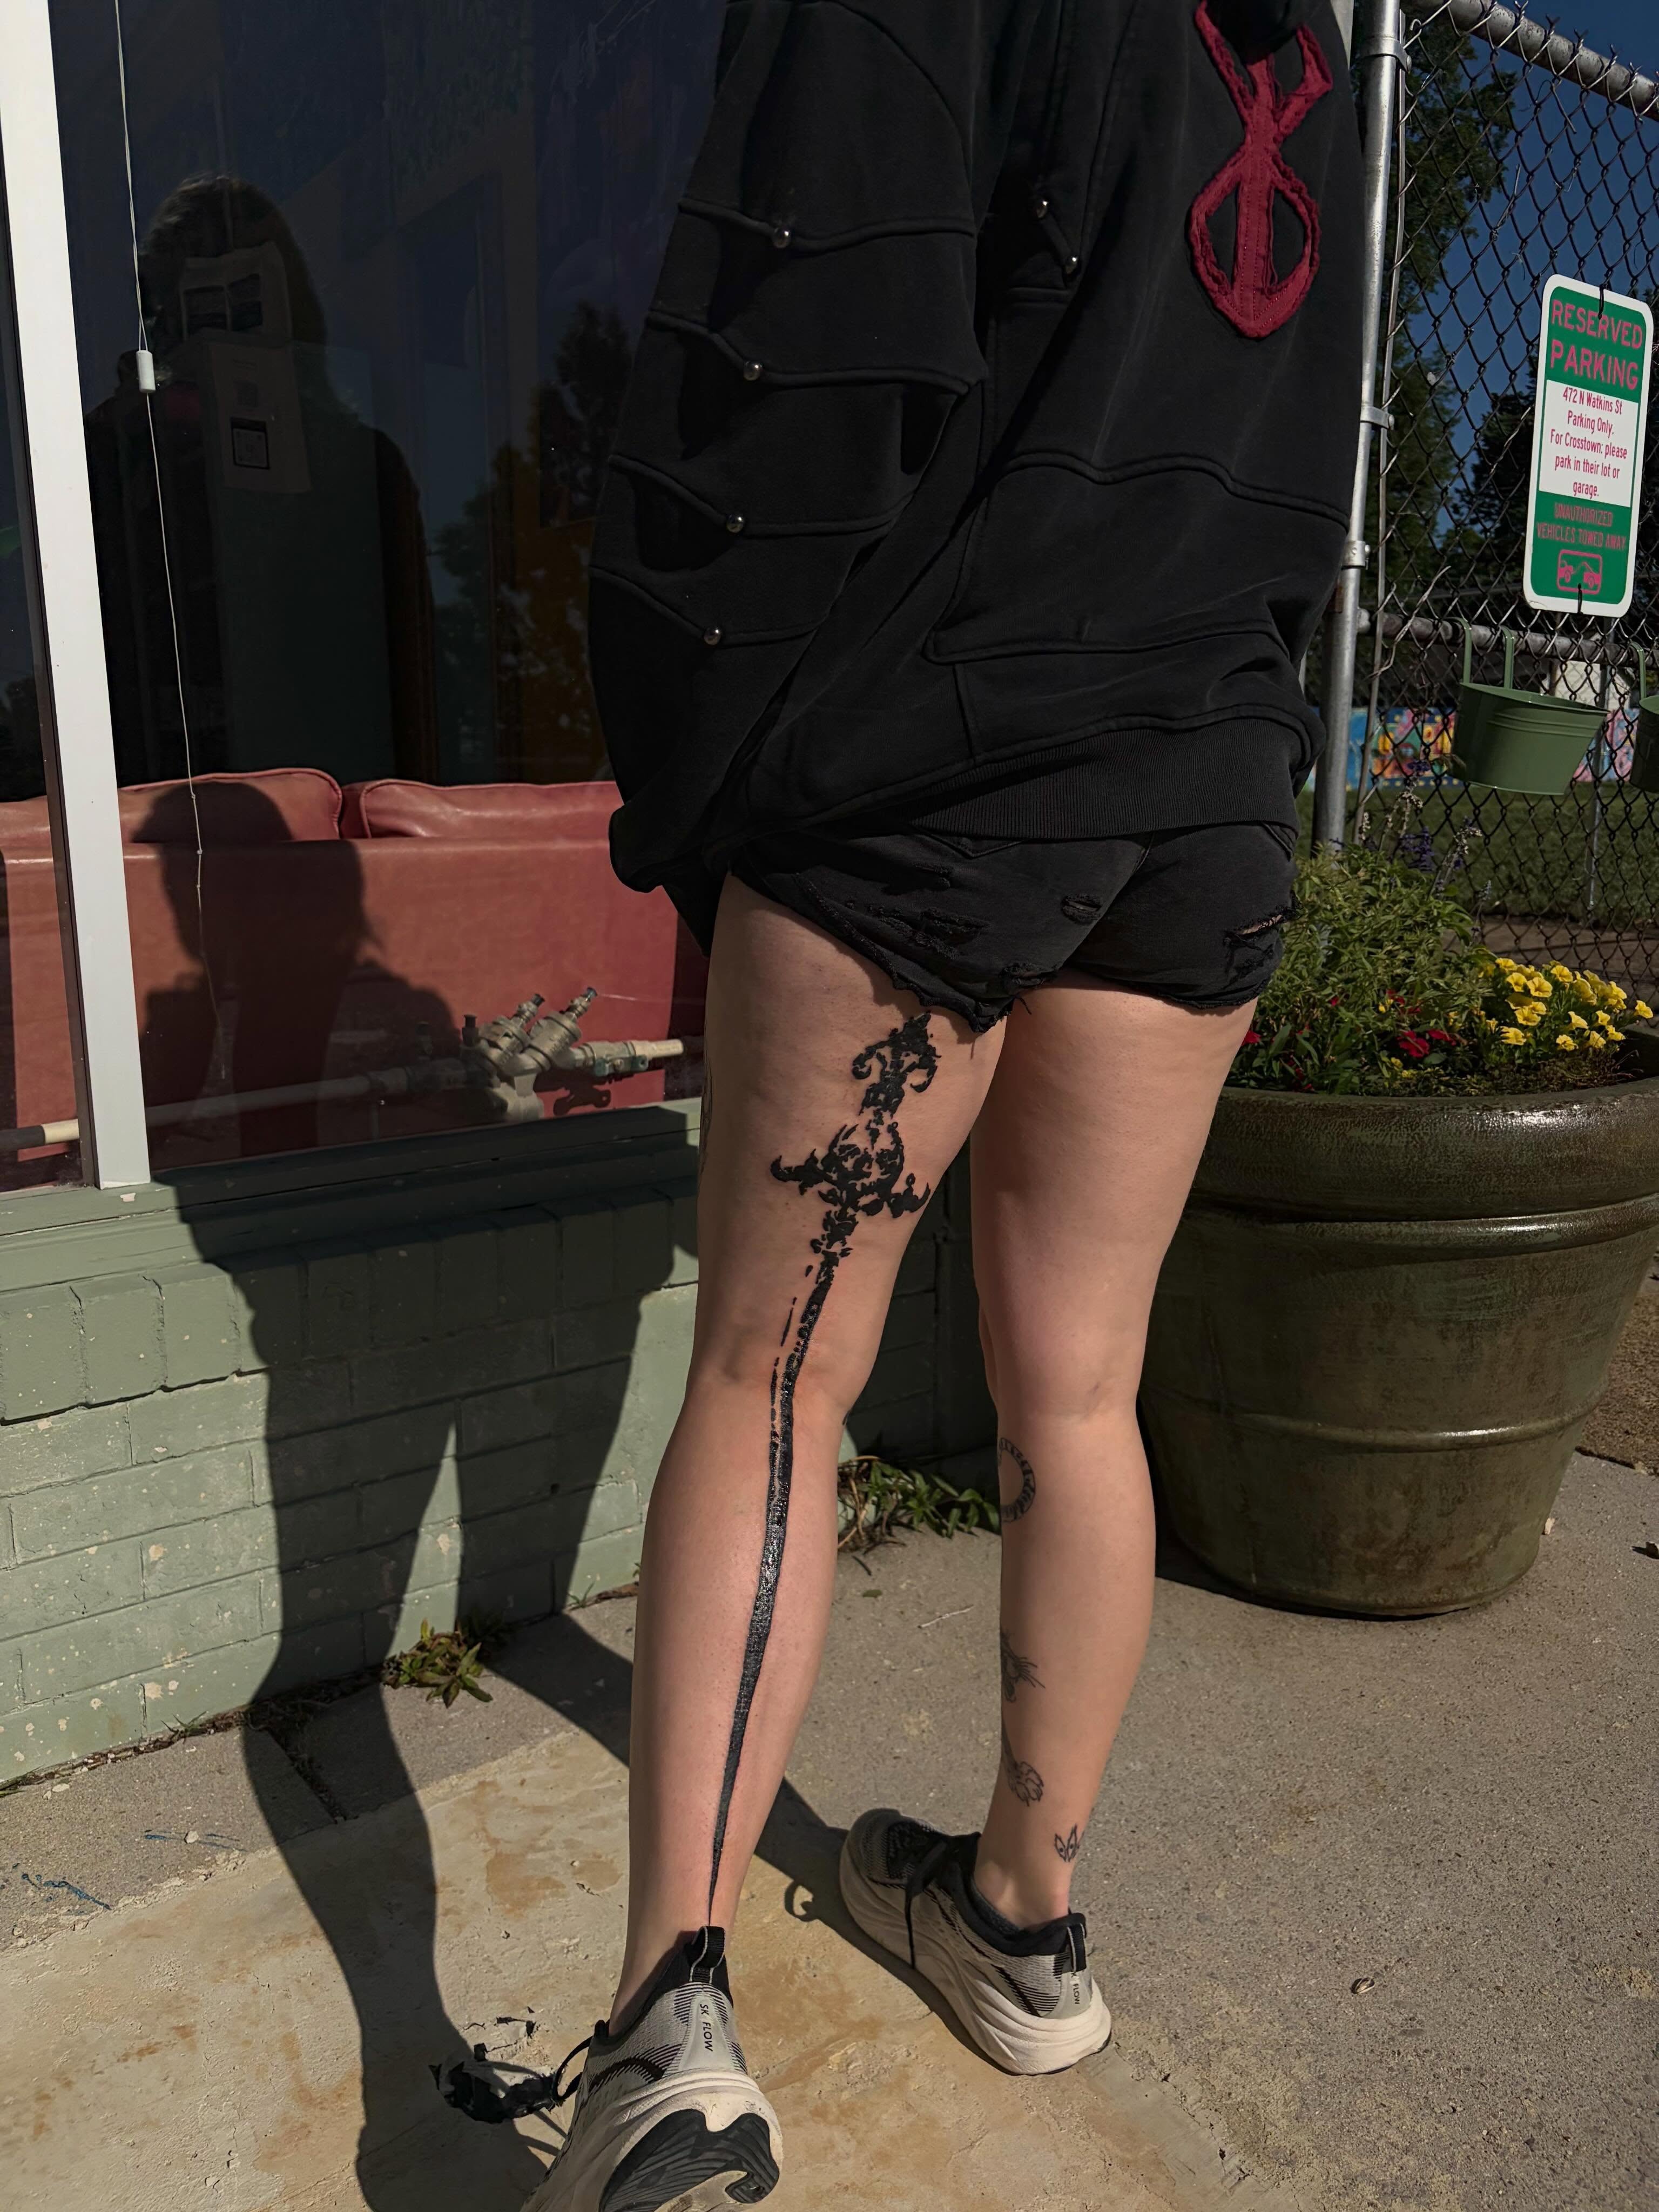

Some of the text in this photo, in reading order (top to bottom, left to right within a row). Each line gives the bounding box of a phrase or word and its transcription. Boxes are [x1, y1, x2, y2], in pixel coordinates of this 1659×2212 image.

[1552, 299, 1643, 349] RESERVED
[1550, 339, 1638, 390] PARKING
[1563, 387, 1622, 415] 472 N Watkins St
[1567, 410, 1614, 439] Parking Only.
[1550, 428, 1628, 459] For Crosstown: please
[1555, 455, 1620, 479] park in their lot or
[1573, 482, 1599, 499] garage.
[1554, 503, 1613, 527] UNAUTHORIZED
[1537, 522, 1627, 551] VEHICLES TOWED AWAY
[1073, 1983, 1081, 2005] FLOW
[700, 2004, 713, 2052] SK FLOW
